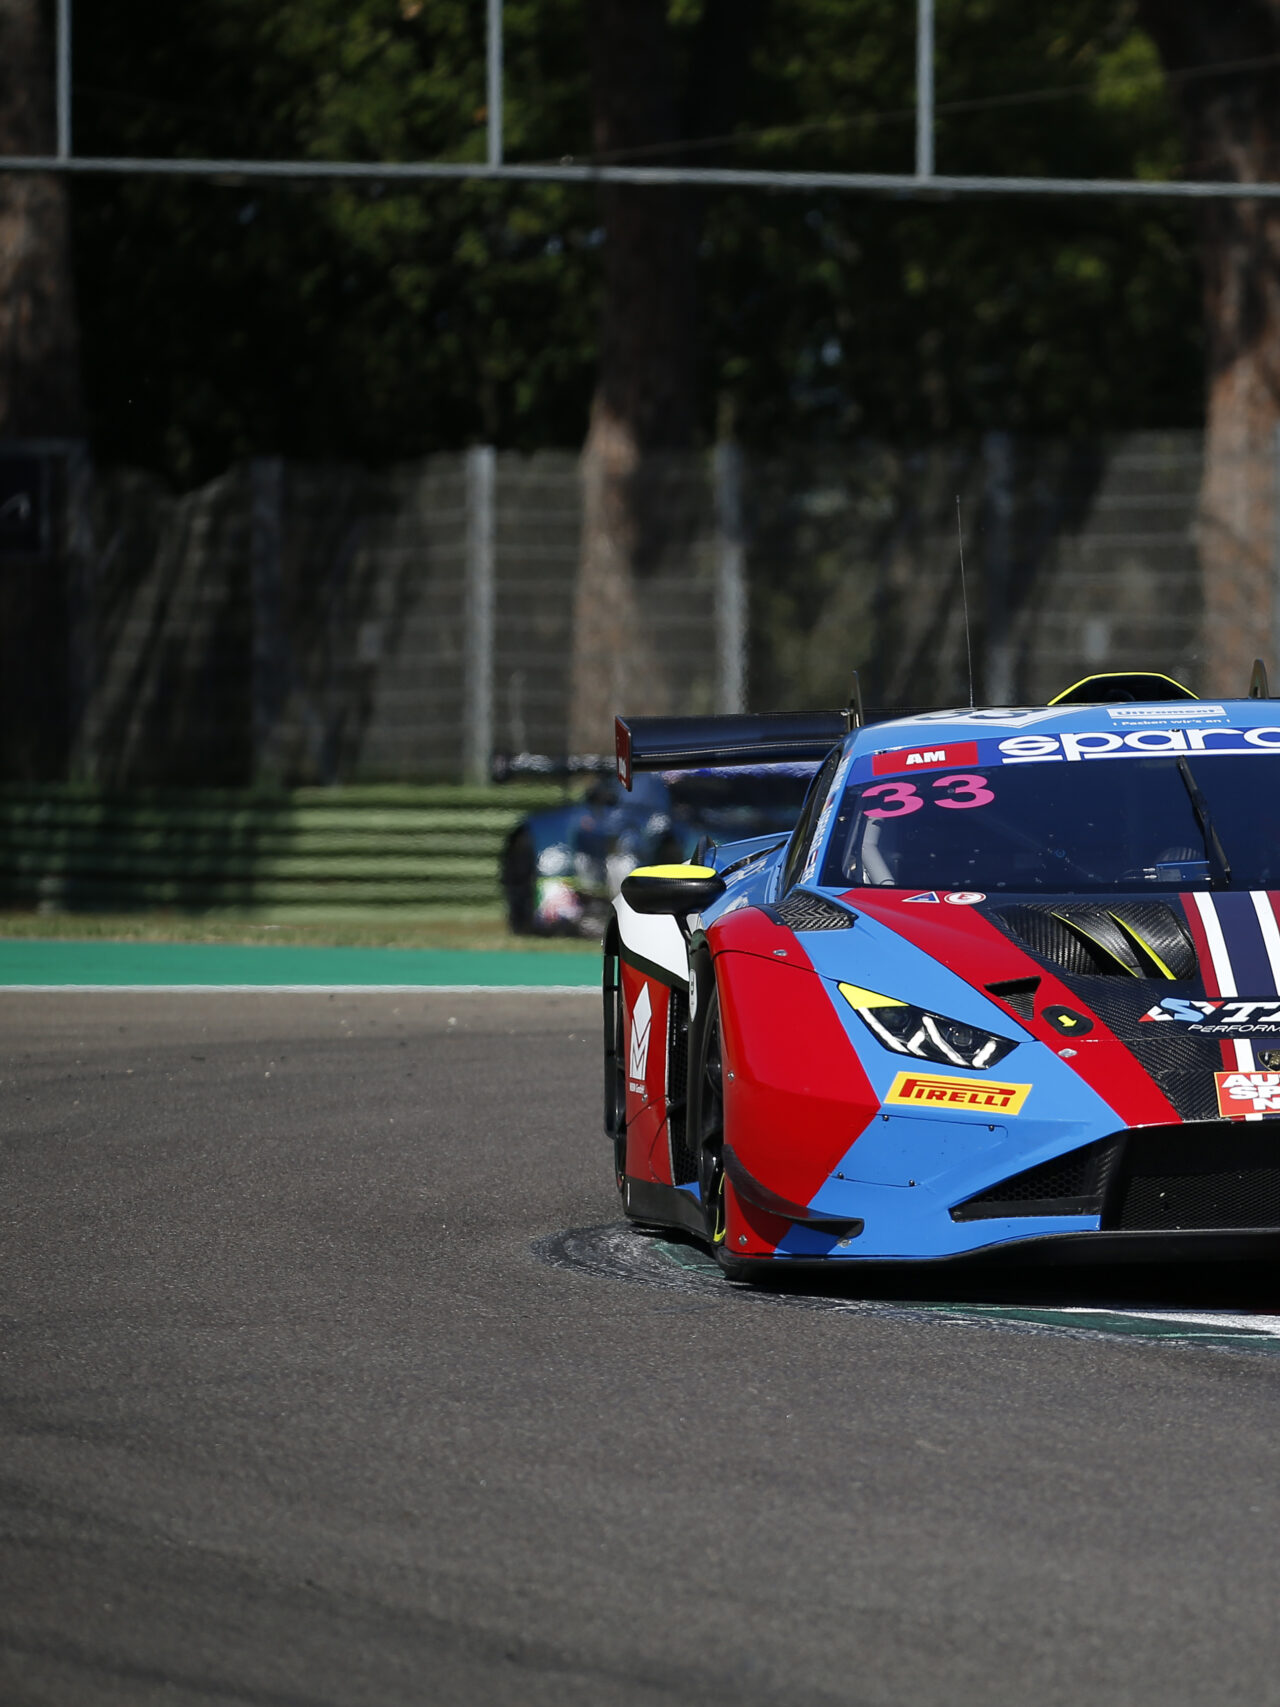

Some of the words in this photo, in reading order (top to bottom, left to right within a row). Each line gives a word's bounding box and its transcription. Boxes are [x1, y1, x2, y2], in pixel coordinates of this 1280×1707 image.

[905, 750, 946, 766] AM
[861, 774, 995, 818] 33
[898, 1078, 1016, 1107] PIRELLI
